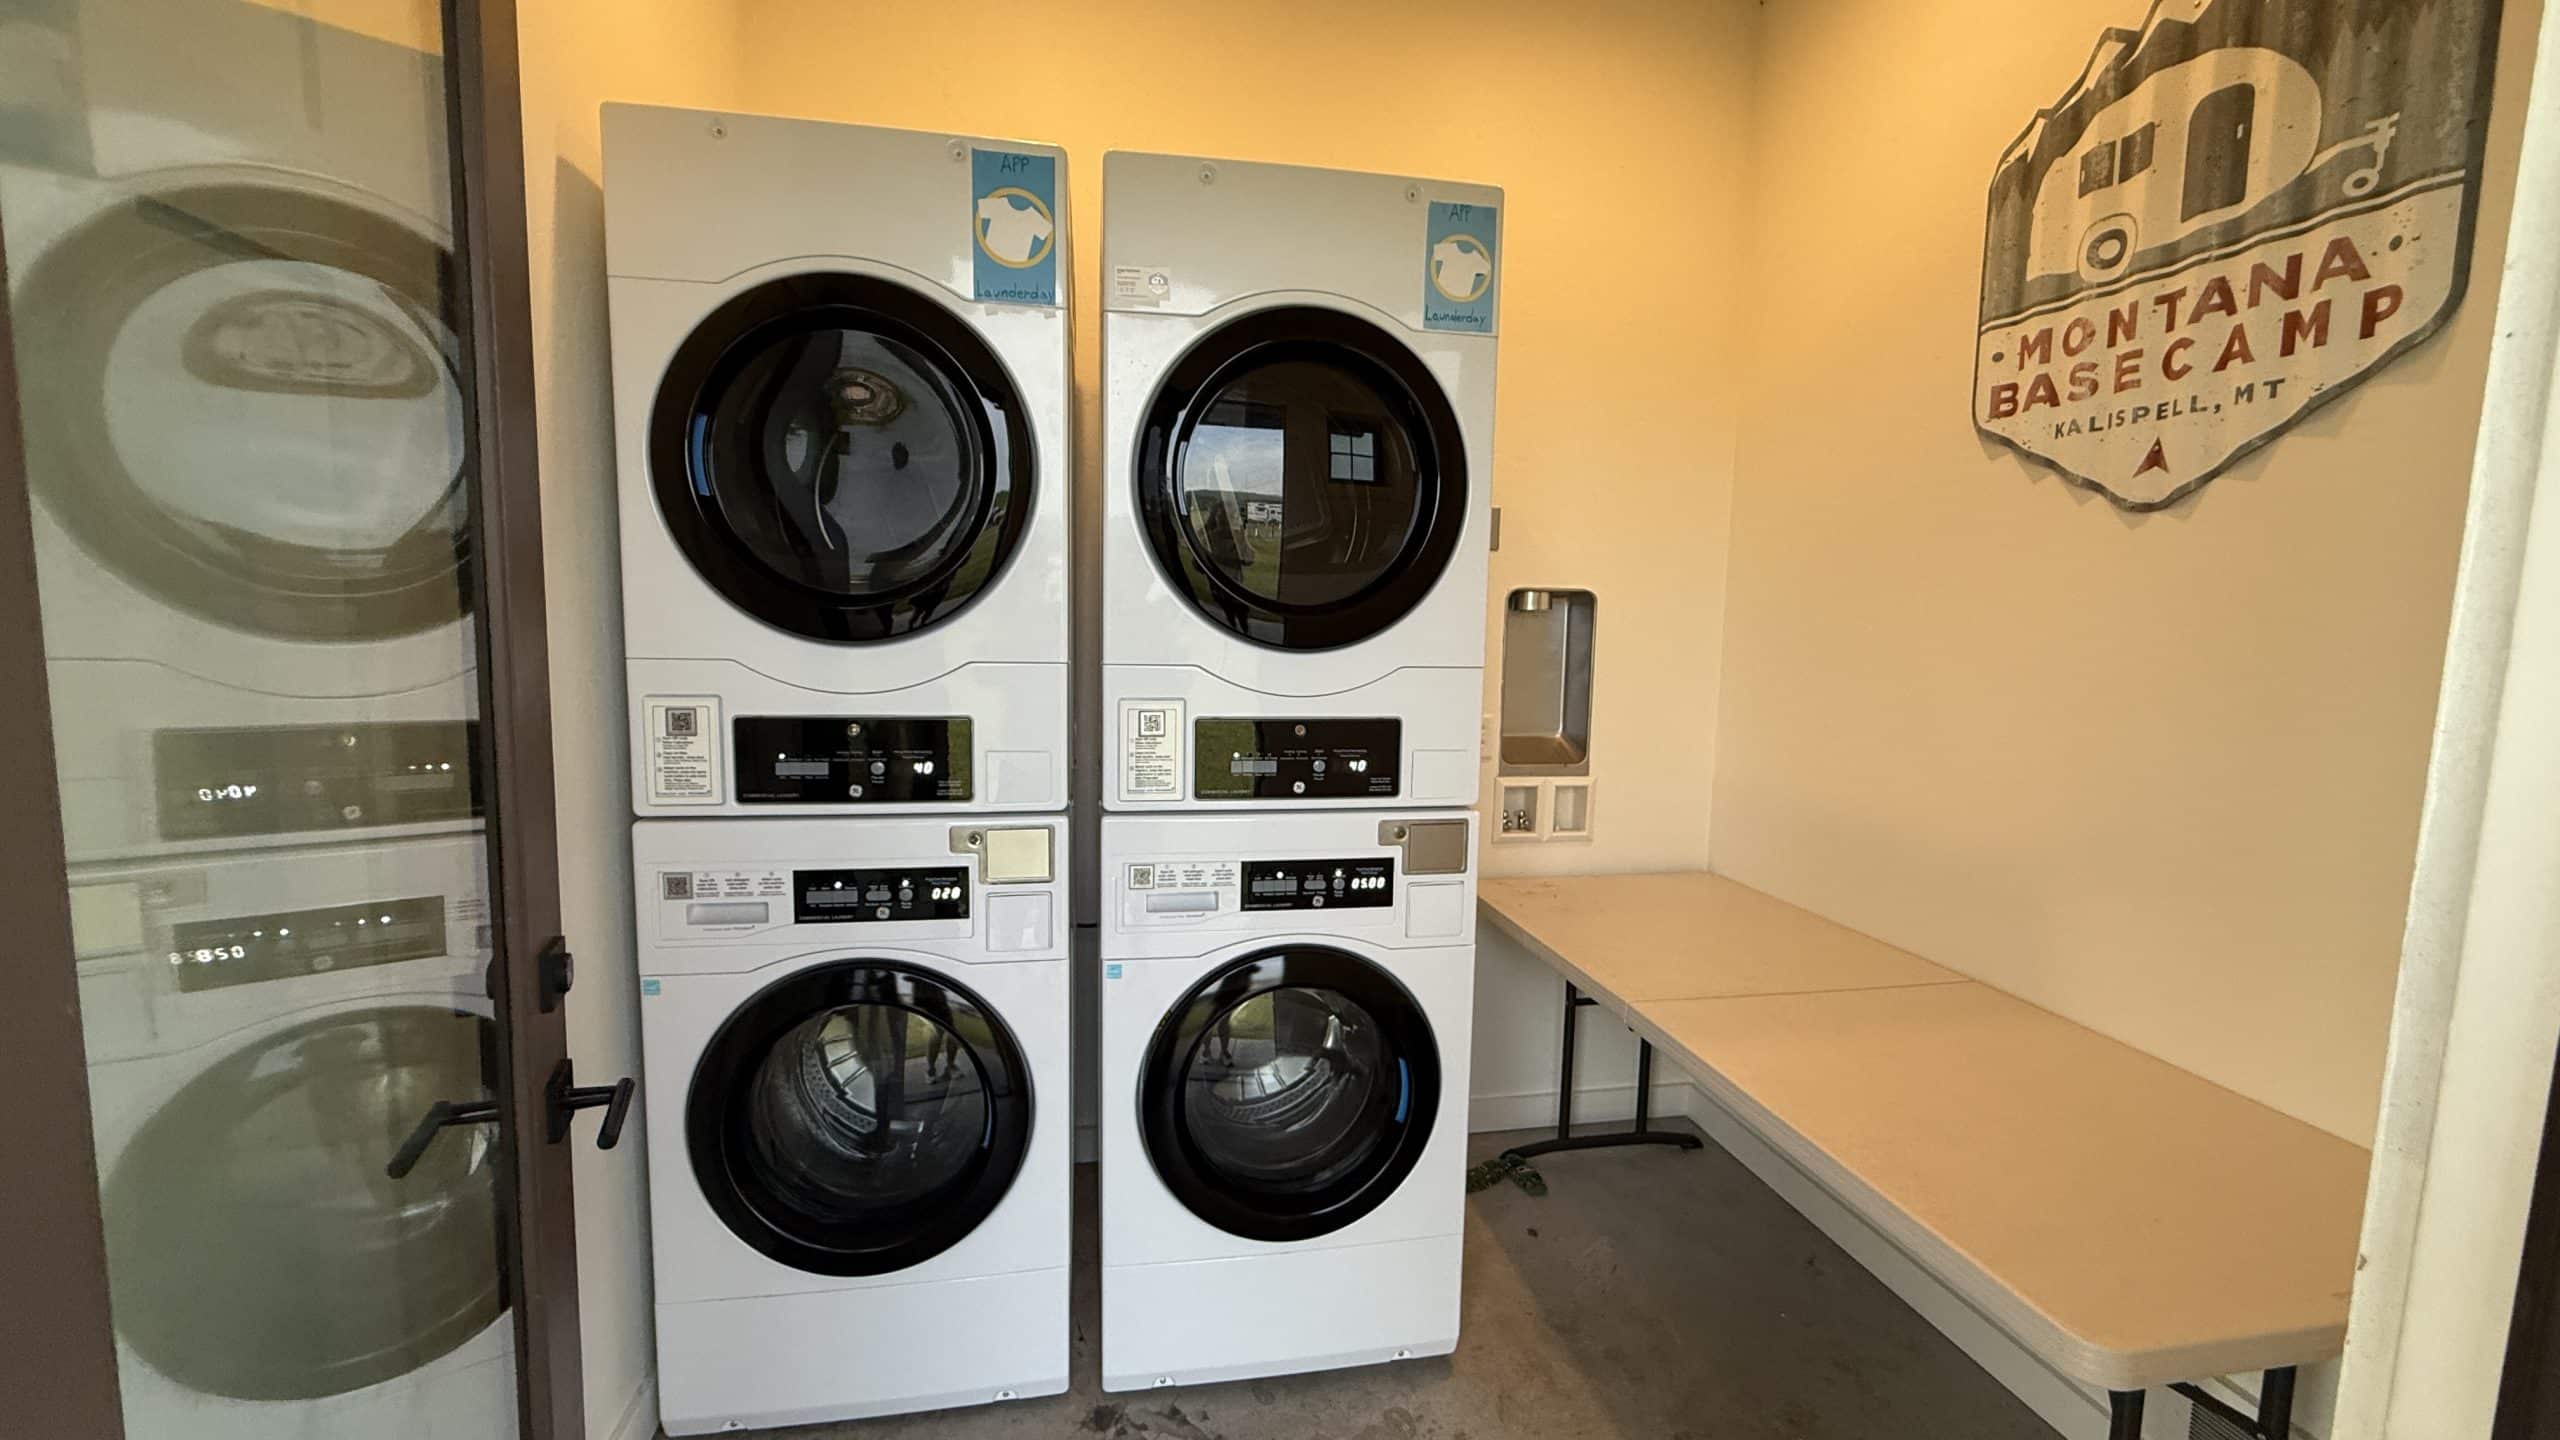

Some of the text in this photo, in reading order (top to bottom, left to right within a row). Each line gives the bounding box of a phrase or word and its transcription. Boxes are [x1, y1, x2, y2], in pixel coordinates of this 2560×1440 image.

[999, 153, 1030, 173] APP
[2017, 236, 2372, 372] MONTANA
[1987, 284, 2405, 422] BASECAMP
[2053, 377, 2287, 440] KALISPELL, MT
[912, 760, 935, 775] 40
[1348, 759, 1368, 773] 40
